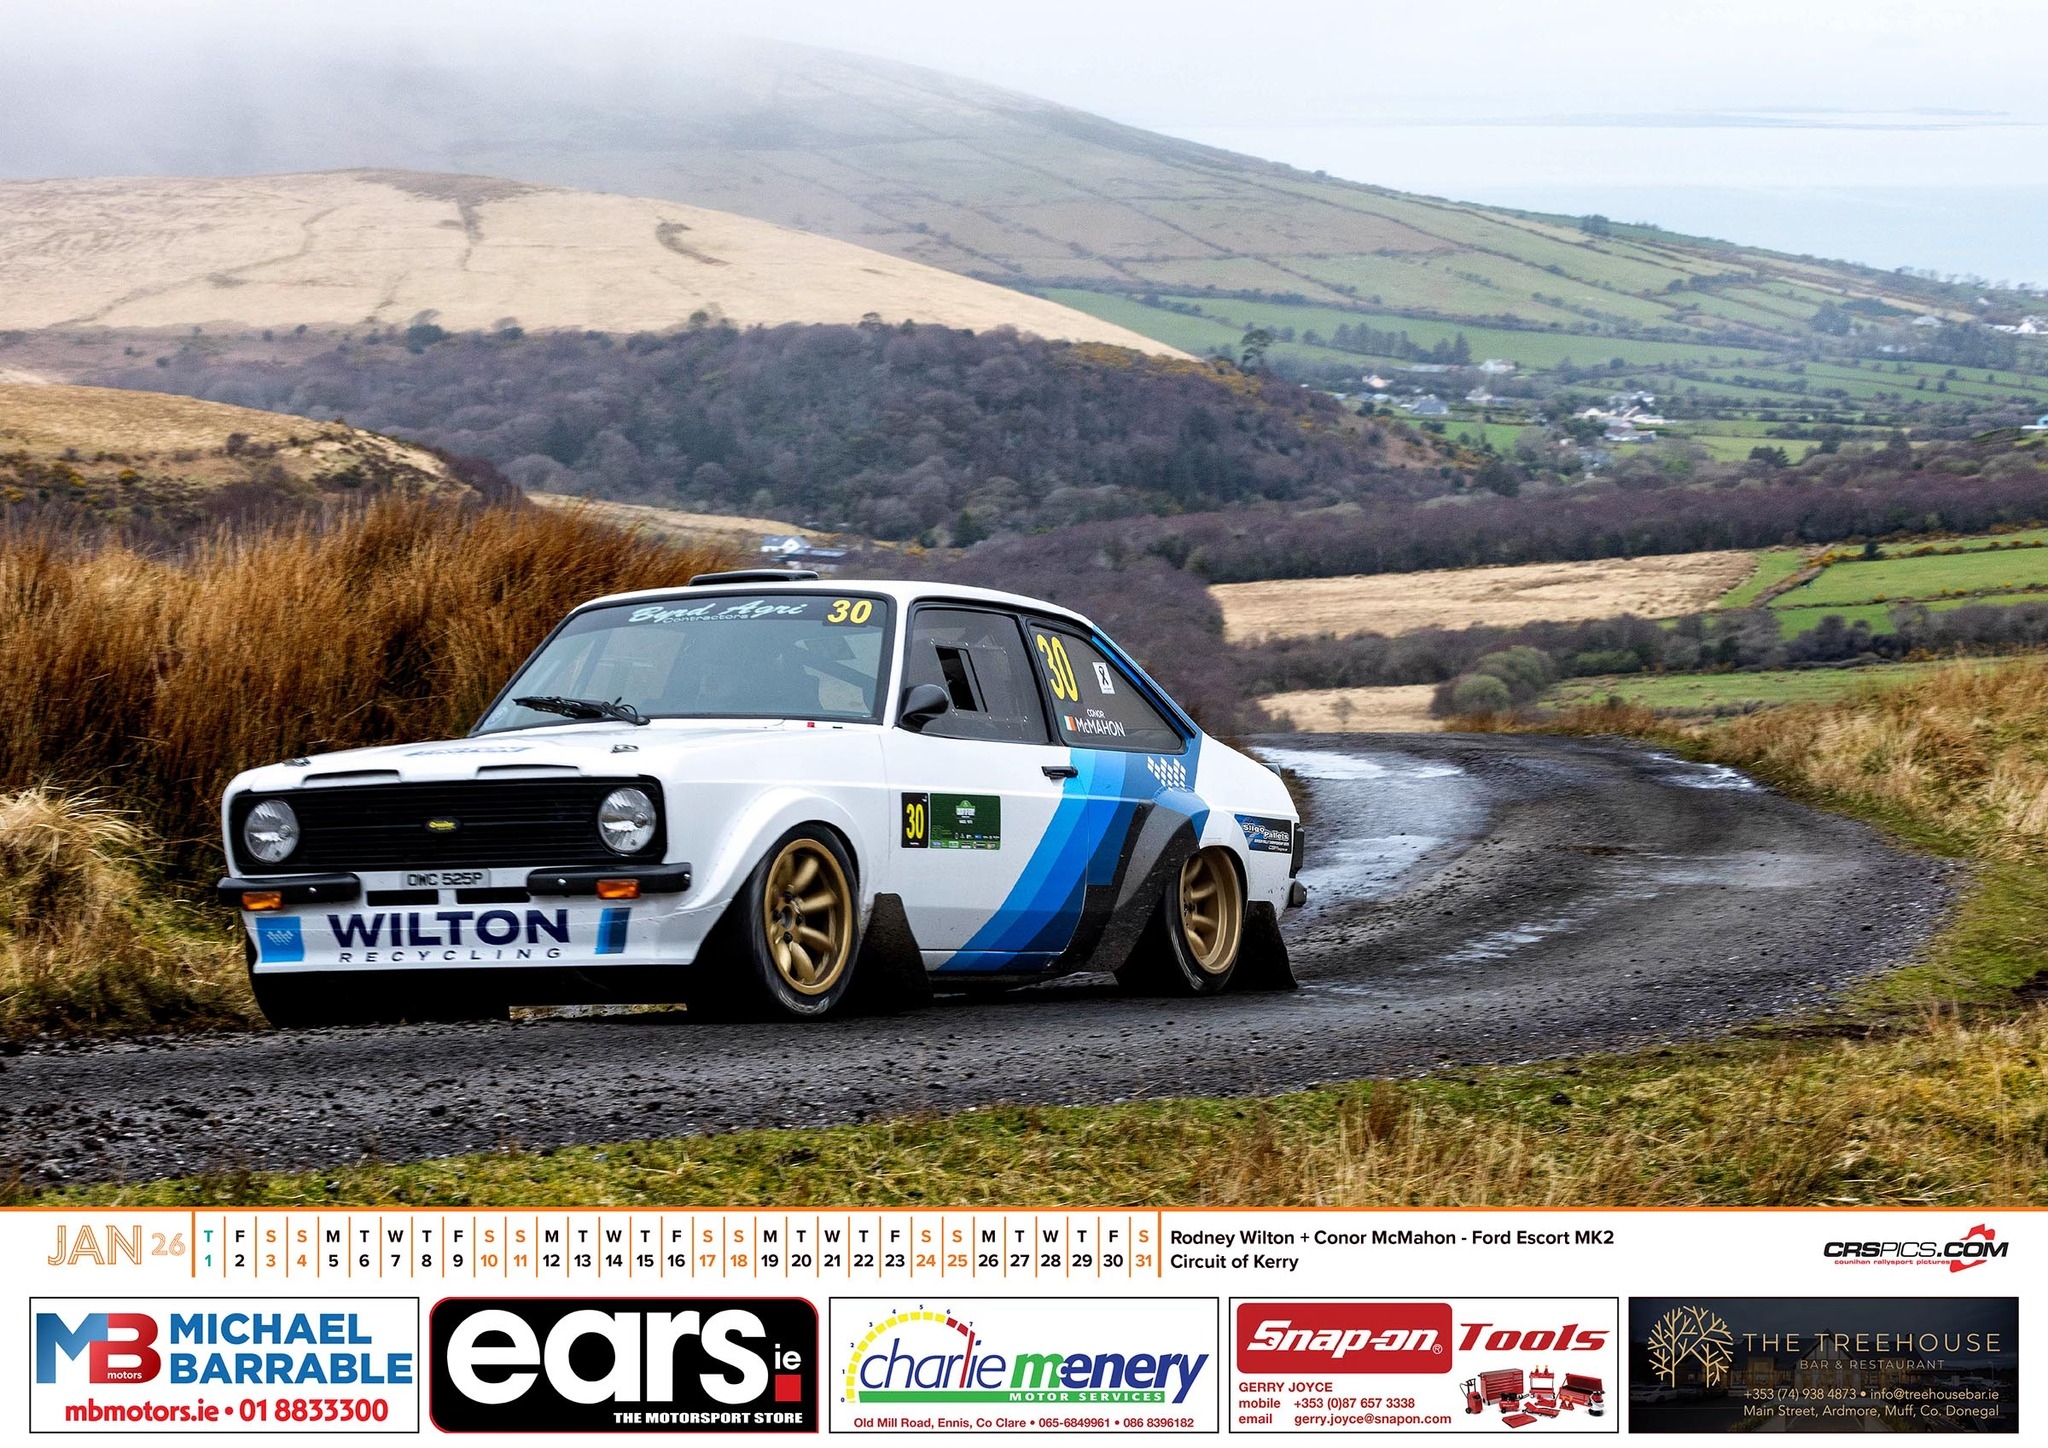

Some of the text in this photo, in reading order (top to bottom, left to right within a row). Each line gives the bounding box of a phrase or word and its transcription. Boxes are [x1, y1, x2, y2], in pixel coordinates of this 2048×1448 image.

[718, 600, 808, 618] Agri
[827, 599, 873, 624] 30
[1036, 634, 1079, 702] 30
[1075, 717, 1126, 737] McMAHON
[906, 803, 924, 839] 30
[442, 871, 483, 885] 525P
[327, 909, 570, 948] WILTON
[339, 948, 562, 963] RECYCLING
